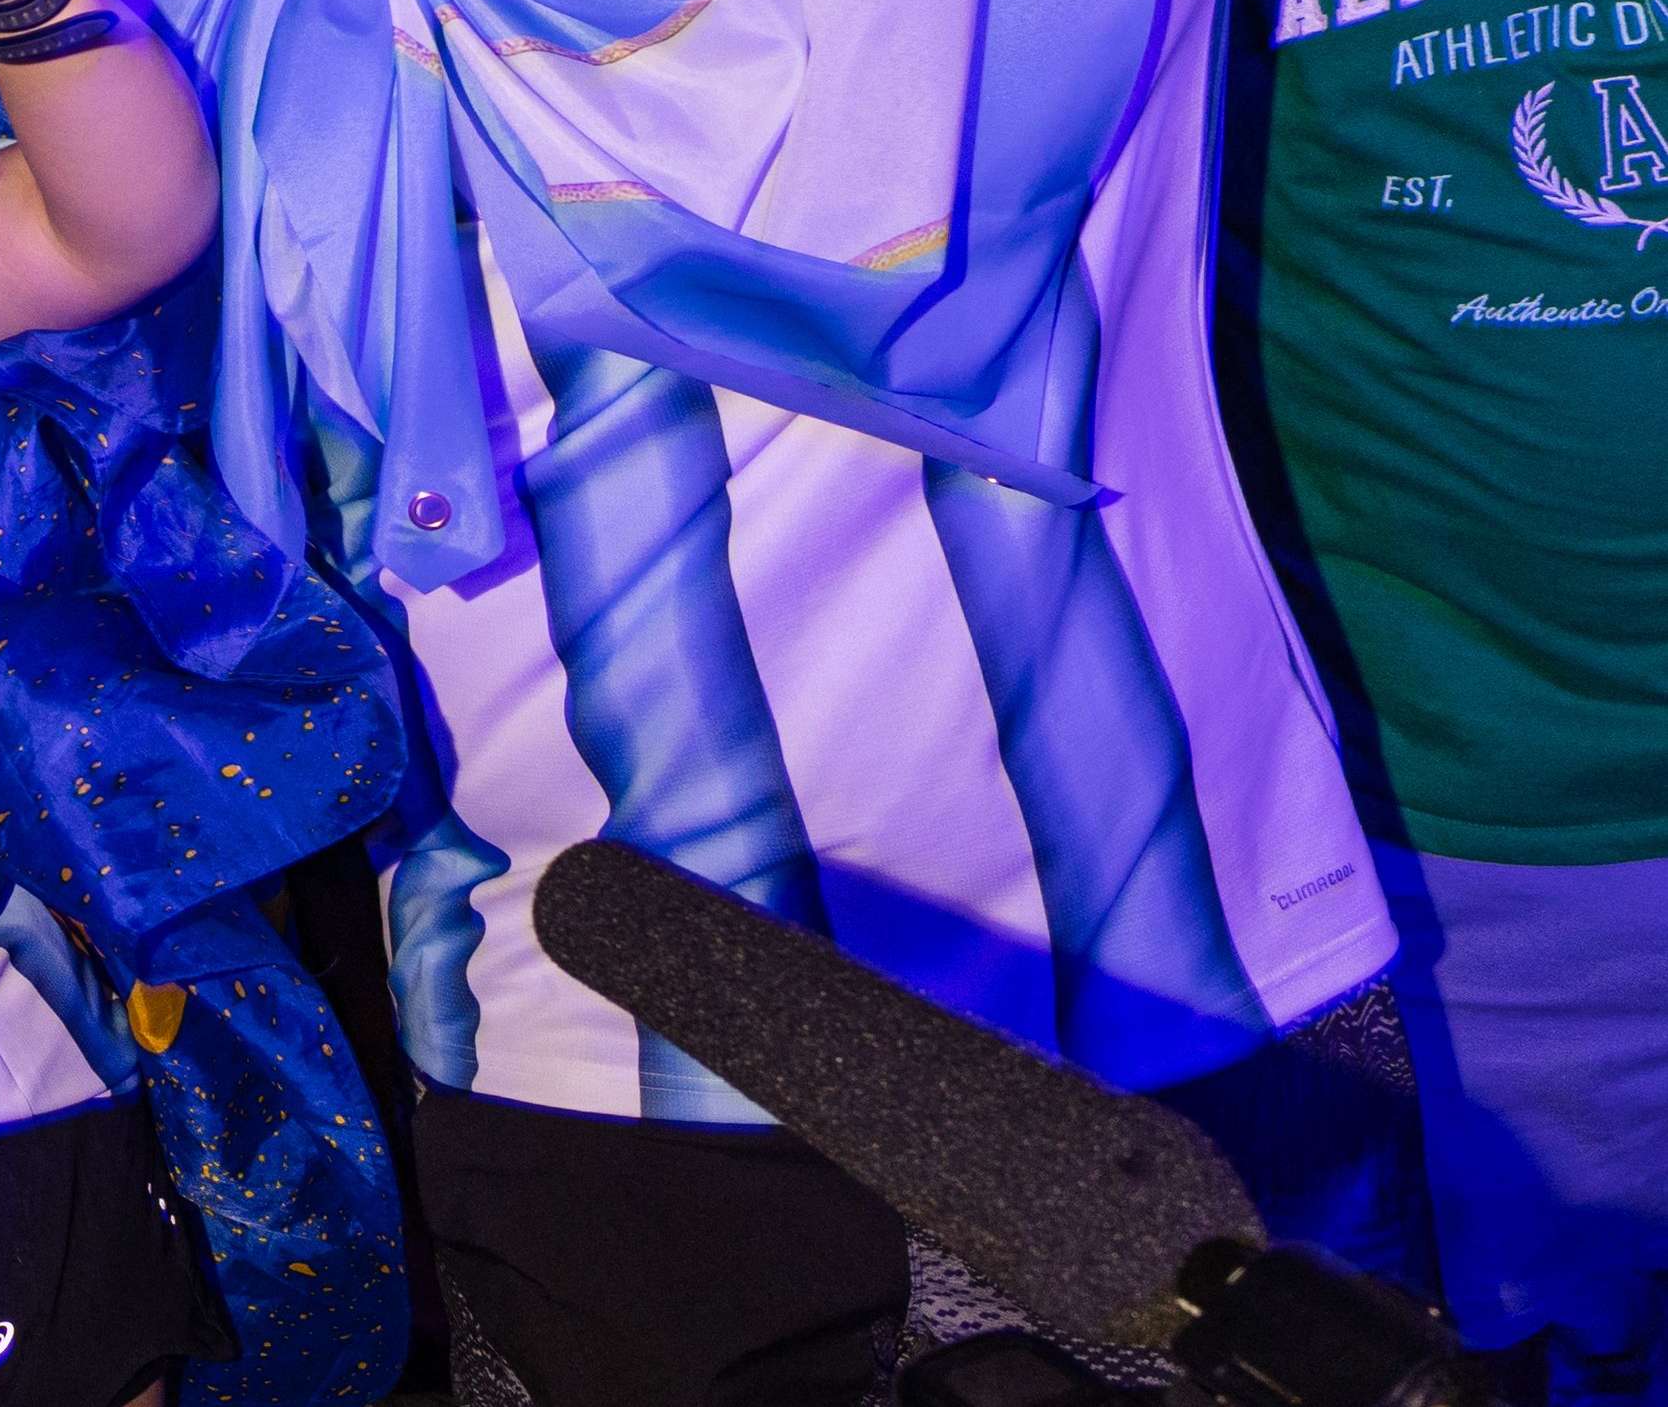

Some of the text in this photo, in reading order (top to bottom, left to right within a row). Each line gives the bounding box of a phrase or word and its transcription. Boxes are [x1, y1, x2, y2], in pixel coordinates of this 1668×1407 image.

[1395, 1, 1596, 85] ATHLETIC
[1382, 174, 1453, 209] EST.
[1450, 293, 1626, 323] Authentic
